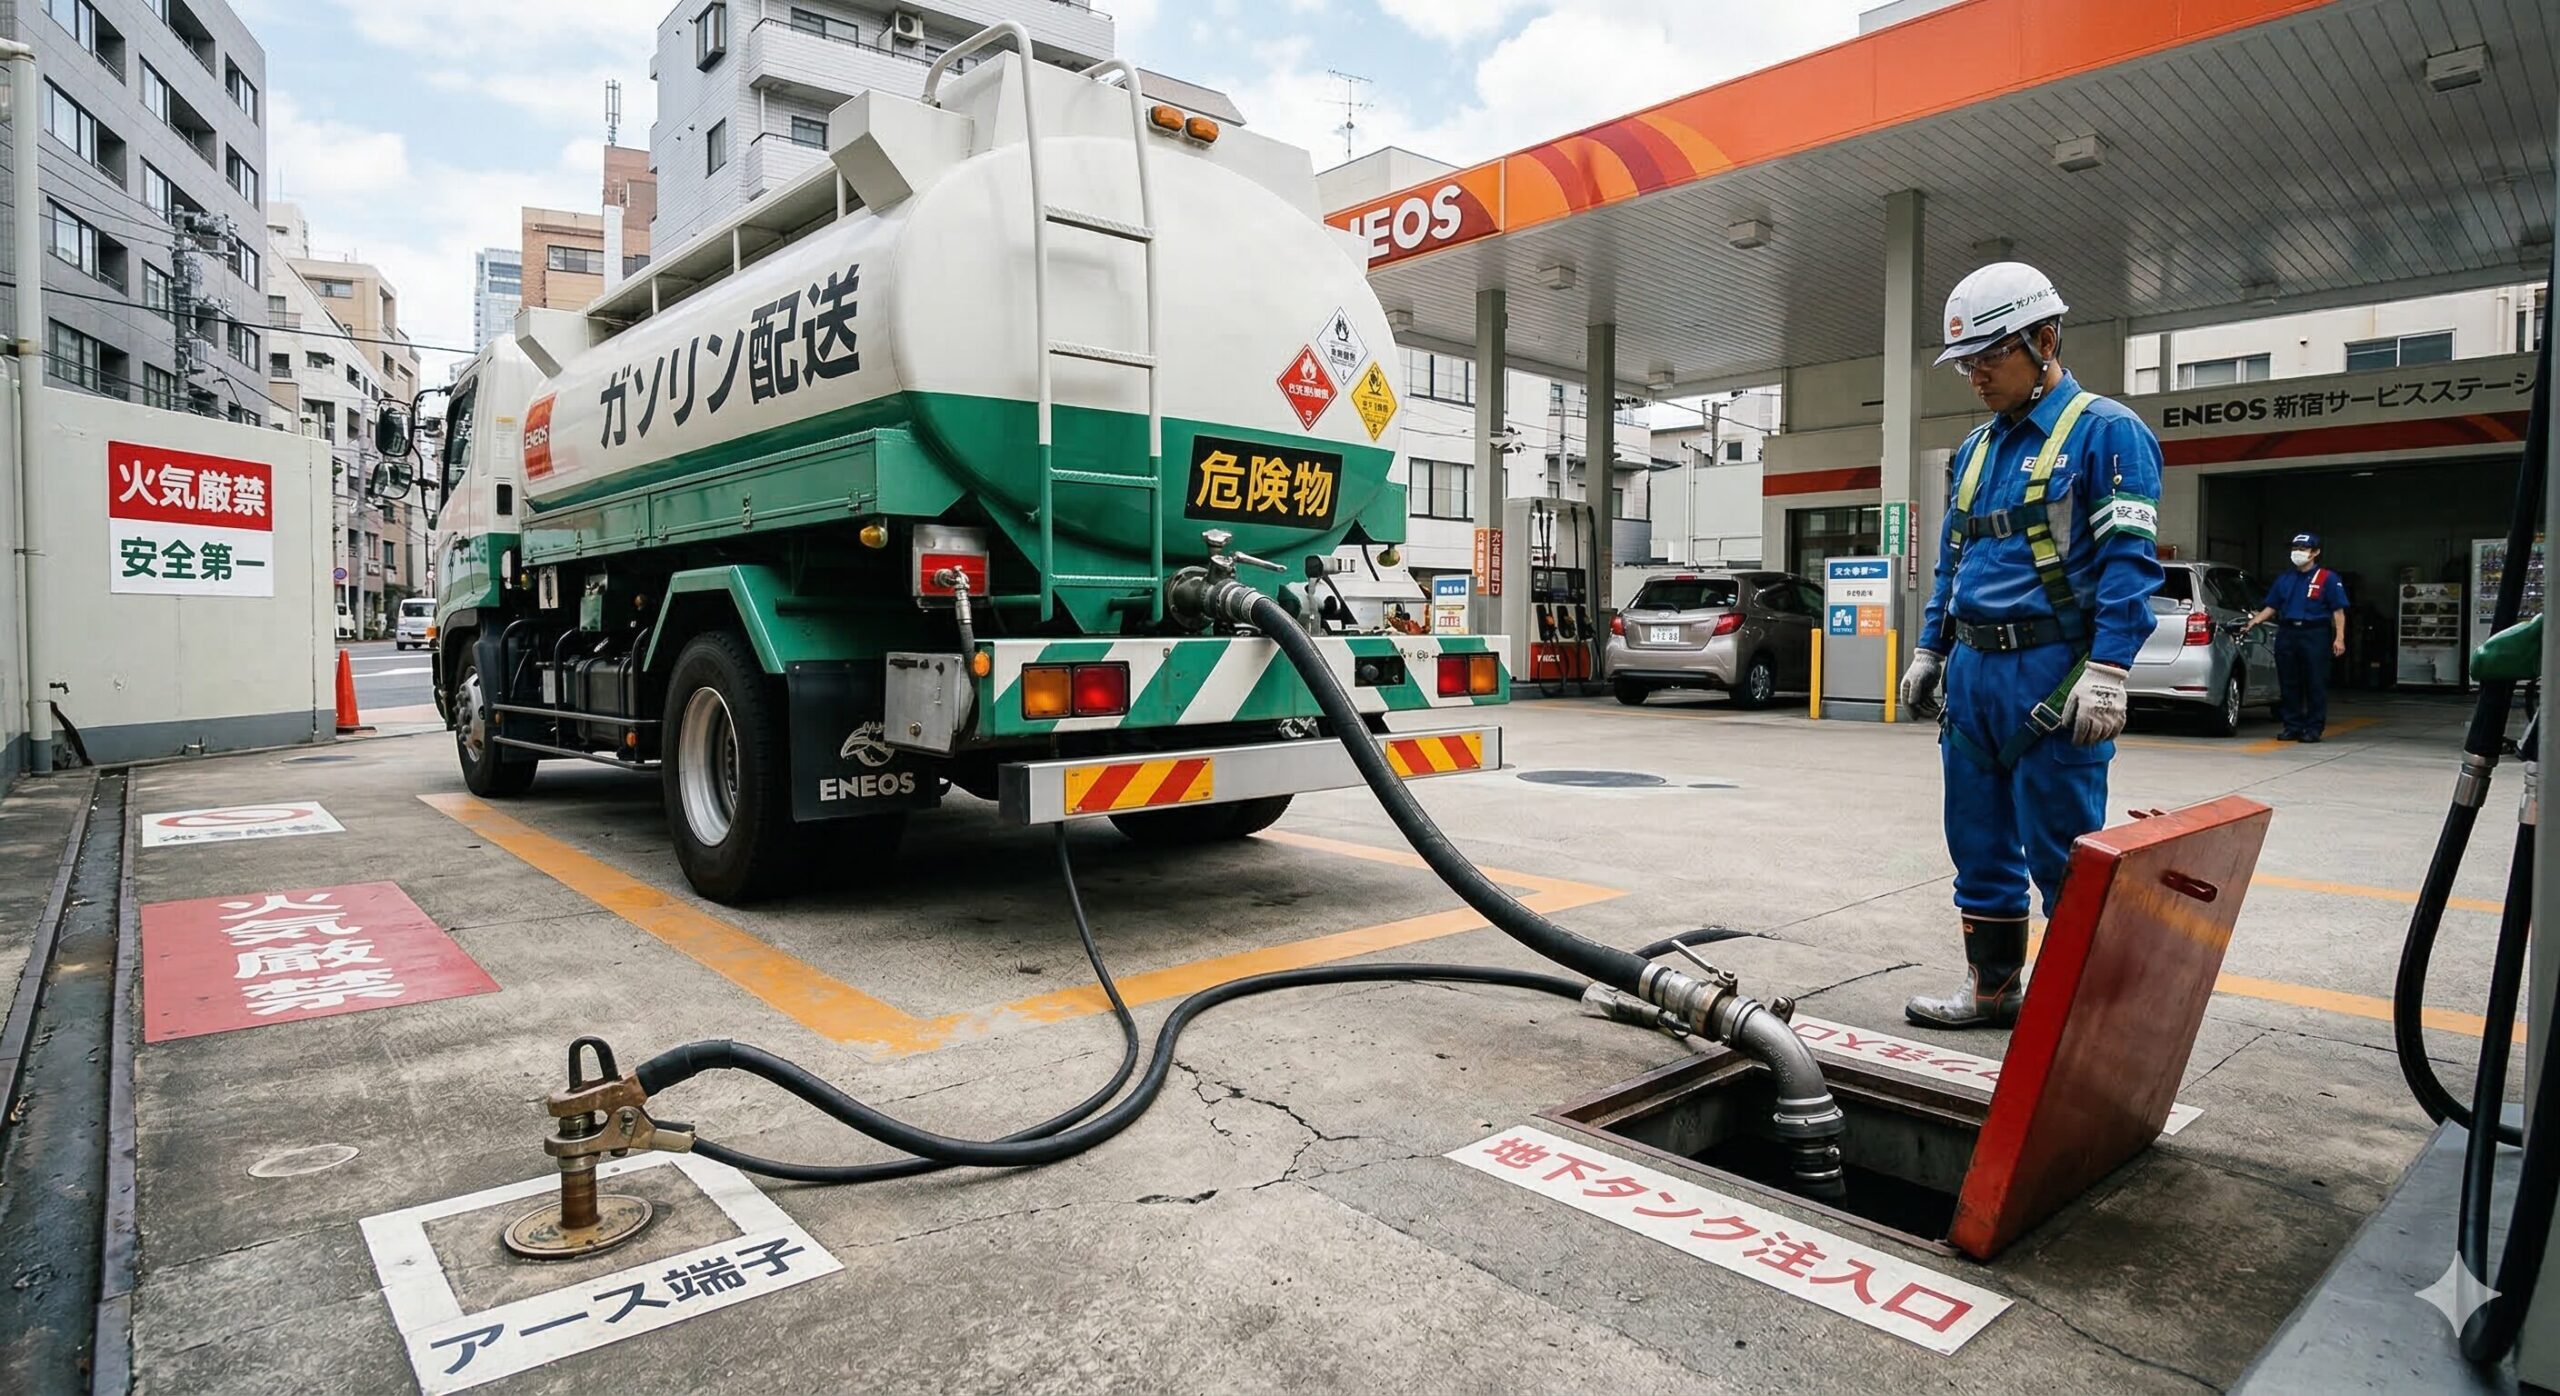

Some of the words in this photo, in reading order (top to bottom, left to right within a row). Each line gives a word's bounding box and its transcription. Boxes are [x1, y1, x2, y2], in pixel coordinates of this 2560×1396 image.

[600, 263, 860, 449] ガソリン配送
[524, 425, 549, 449] ENEOS
[2163, 397, 2267, 428] ENEOS
[119, 459, 266, 517] 火気厳禁
[1195, 450, 1333, 518] 危険物
[120, 536, 265, 581] 安全第一
[819, 771, 916, 802] ENEOS
[217, 893, 406, 1016] 火気厳禁
[1484, 1136, 1974, 1334] 地下タンク注入口
[429, 1237, 805, 1376] アース端子
